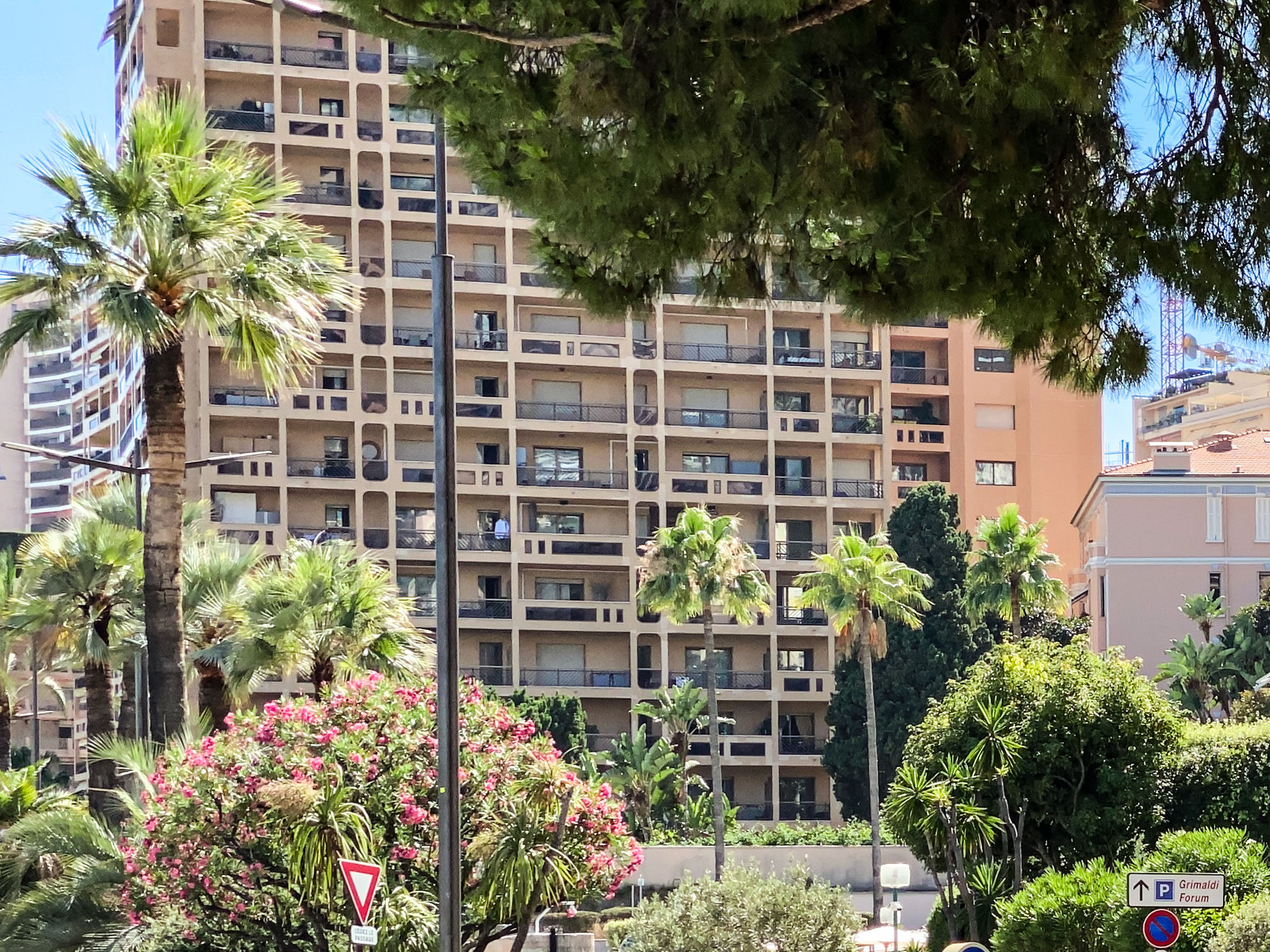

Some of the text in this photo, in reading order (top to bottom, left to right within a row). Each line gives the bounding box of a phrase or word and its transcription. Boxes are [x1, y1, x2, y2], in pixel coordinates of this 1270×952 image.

[1159, 881, 1170, 897] P
[1178, 879, 1220, 890] Grimaldi
[1179, 892, 1210, 903] Forum
